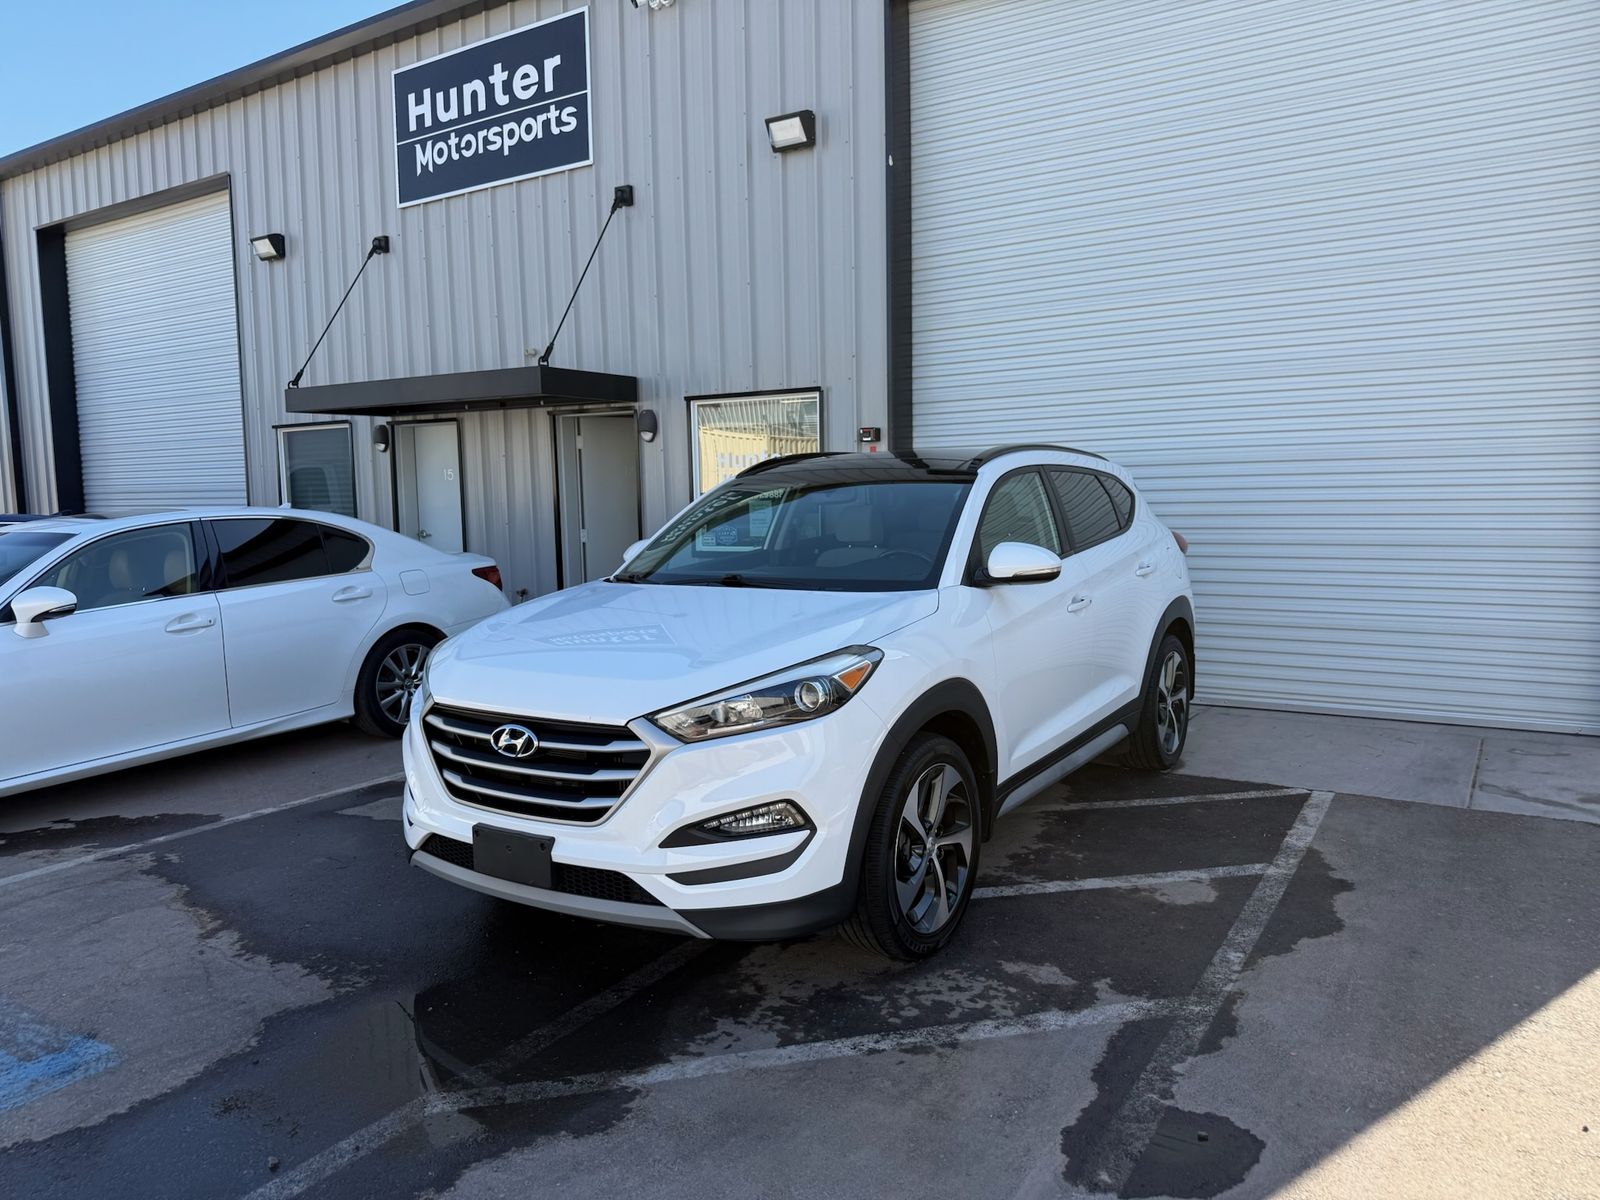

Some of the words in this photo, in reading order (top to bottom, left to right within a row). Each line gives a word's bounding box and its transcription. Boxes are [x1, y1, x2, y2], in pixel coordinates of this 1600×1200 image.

[407, 54, 561, 132] Hunter
[414, 104, 578, 177] Motorsports
[443, 468, 454, 481] 15
